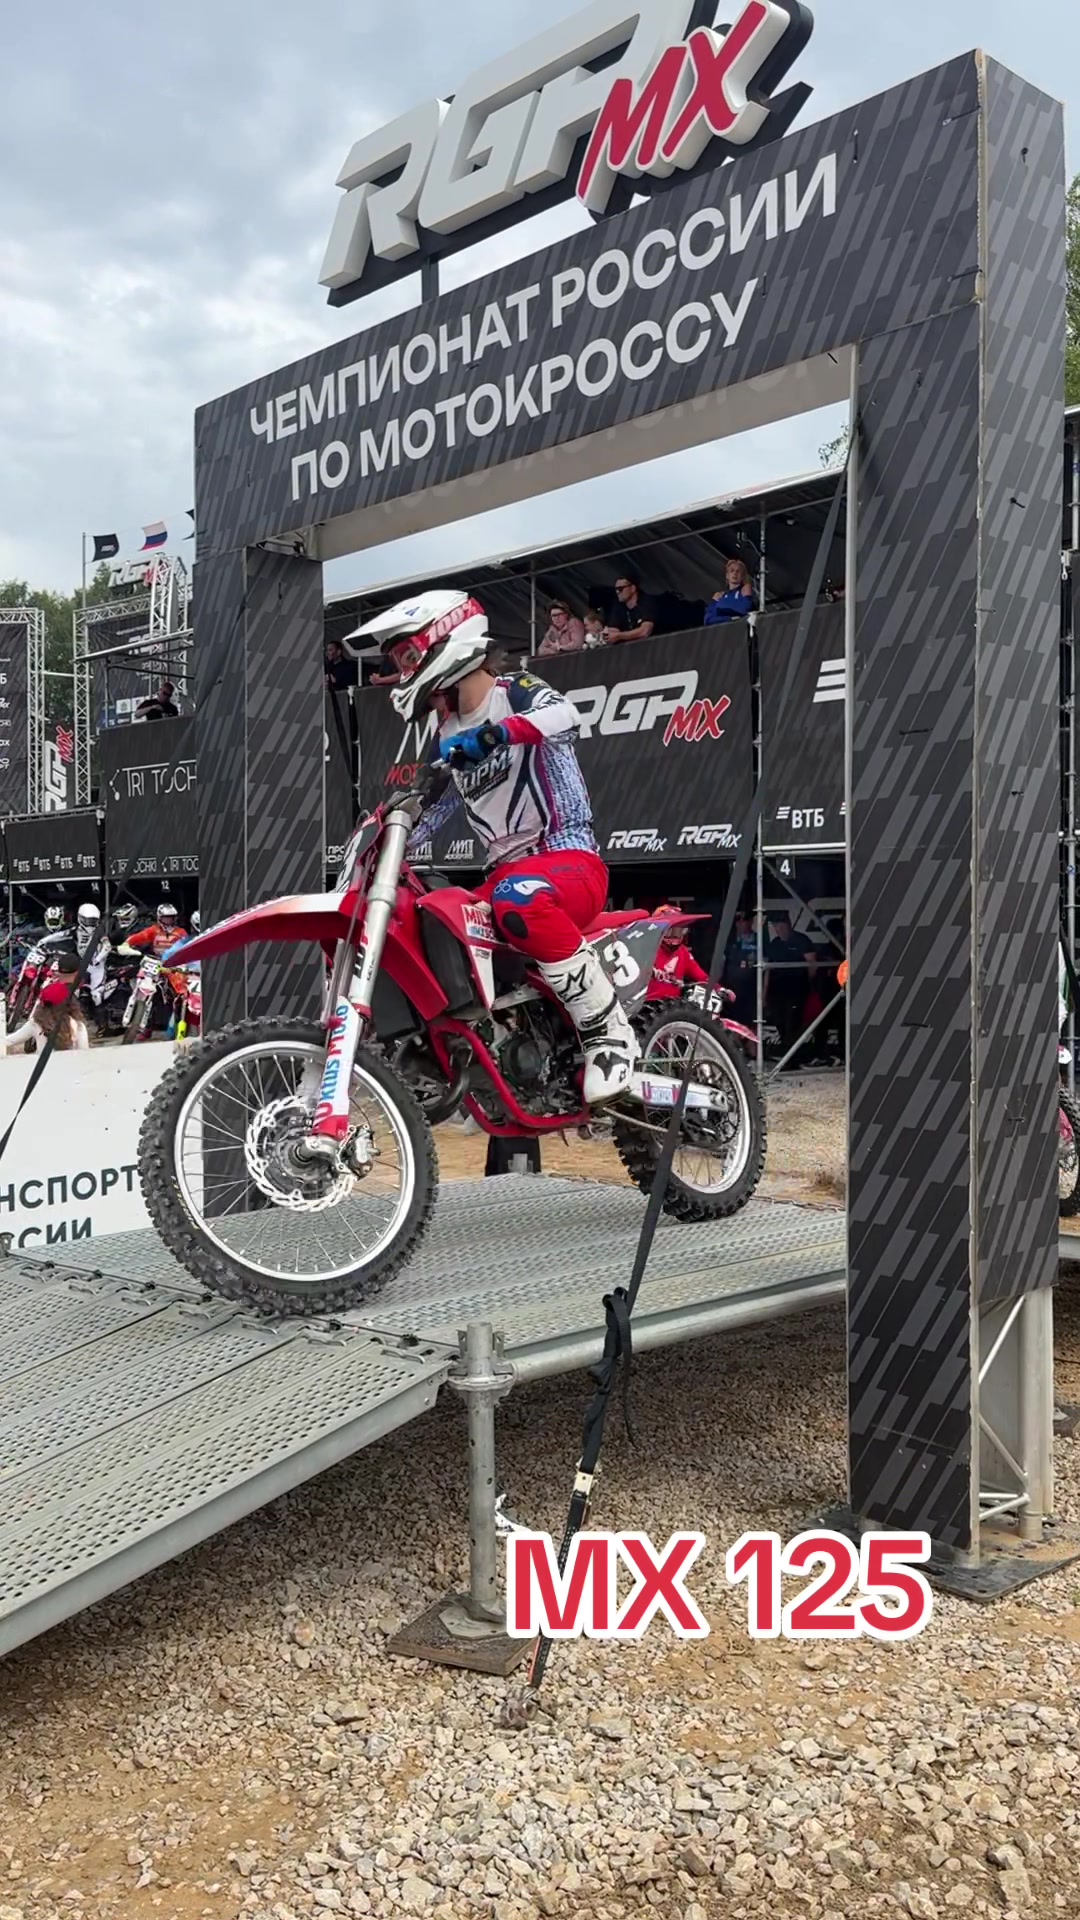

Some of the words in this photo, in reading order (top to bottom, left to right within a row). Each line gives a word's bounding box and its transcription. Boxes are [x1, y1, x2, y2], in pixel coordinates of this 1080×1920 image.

[576, 0, 789, 213] MX
[250, 283, 540, 444] ЧЕМПИОНАТ
[551, 153, 837, 328] РОССИИ
[291, 440, 350, 501] ПО
[359, 278, 758, 478] МОТОКРОССУ
[425, 600, 478, 646] 100%
[563, 669, 698, 740] RGP
[663, 694, 731, 747] MX
[607, 829, 659, 849] RGP
[644, 838, 667, 852] MX
[677, 824, 732, 845] RGP
[717, 834, 742, 848] MX
[791, 808, 825, 829] ВТБ
[161, 880, 170, 890] 12
[780, 858, 791, 875] 4
[603, 940, 640, 987] 3
